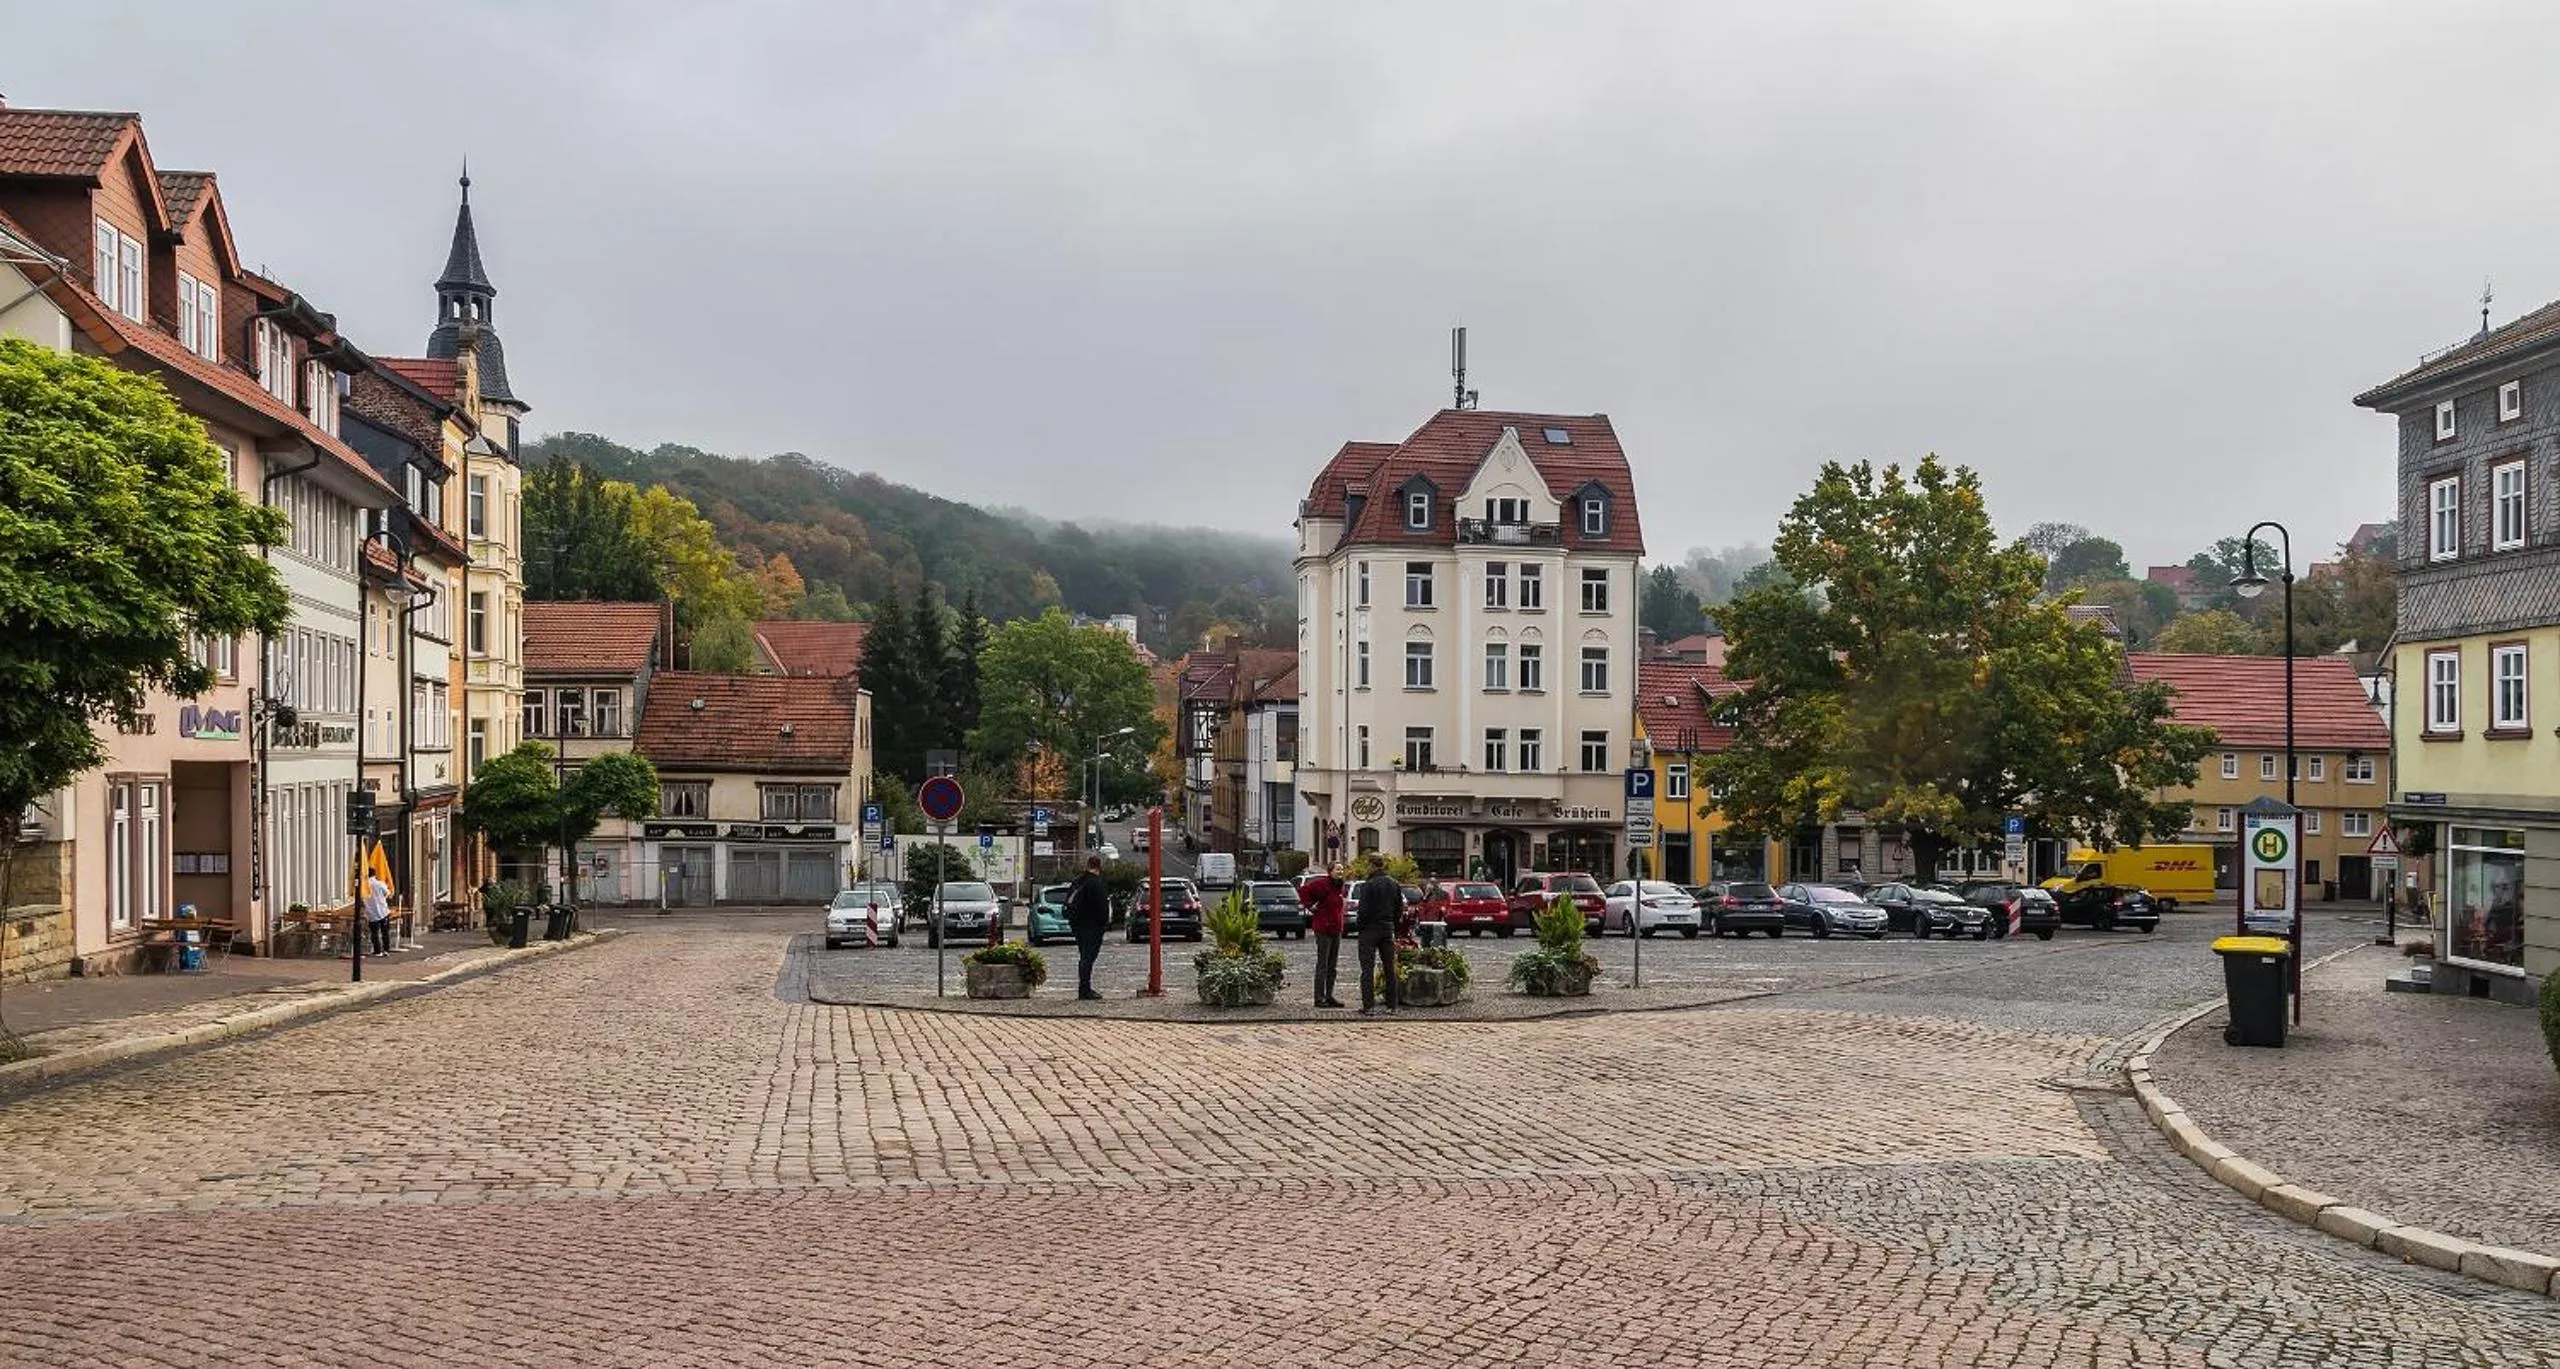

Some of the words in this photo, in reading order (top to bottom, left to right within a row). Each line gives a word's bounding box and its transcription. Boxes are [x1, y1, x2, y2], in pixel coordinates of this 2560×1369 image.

[1633, 772, 1650, 795] P
[1036, 809, 1046, 821] P
[1395, 803, 1465, 817] Konditorei
[1553, 805, 1611, 820] Brüheim
[883, 837, 892, 848] P
[983, 836, 991, 846] P
[2262, 836, 2278, 854] H
[2153, 860, 2197, 871] DHL
